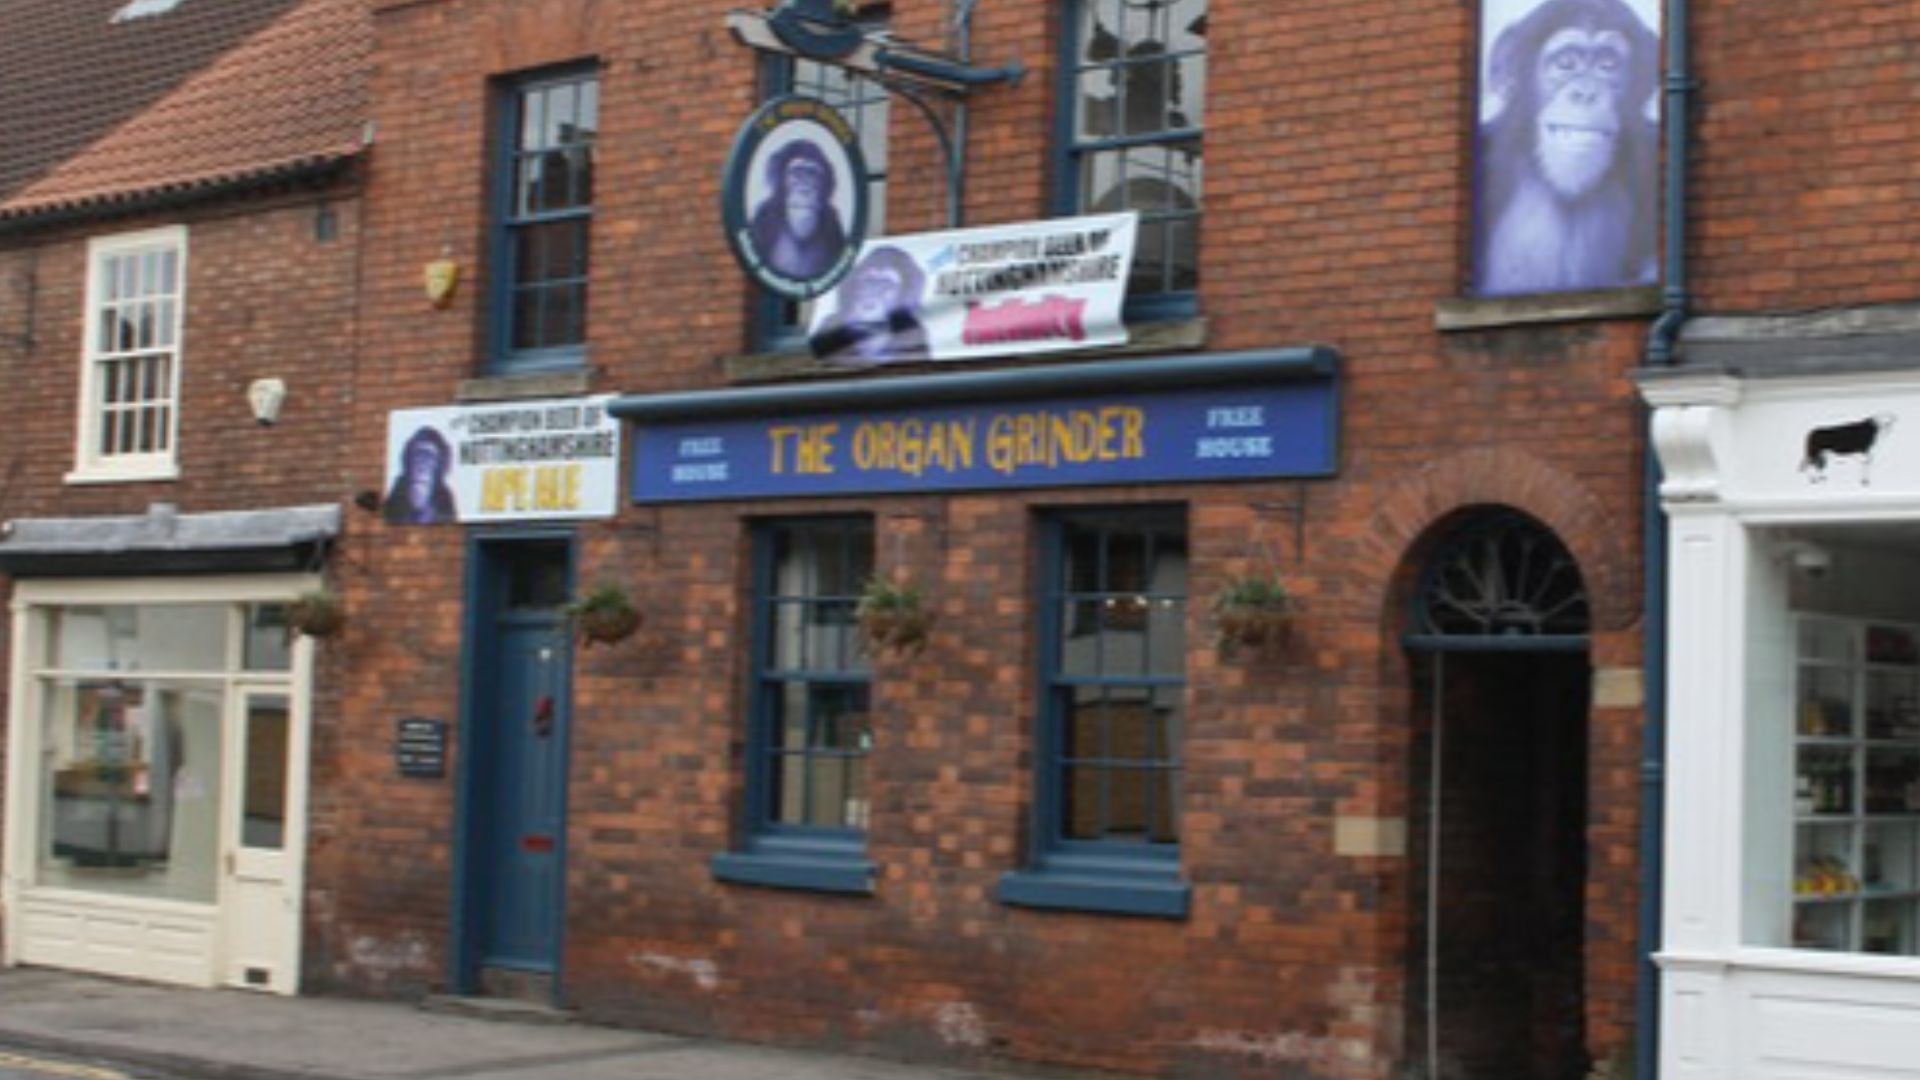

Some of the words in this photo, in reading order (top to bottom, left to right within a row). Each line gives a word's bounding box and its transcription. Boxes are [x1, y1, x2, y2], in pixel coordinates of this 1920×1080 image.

[1207, 406, 1264, 427] FREE
[768, 423, 839, 474] THE
[852, 416, 975, 478] ORGAN
[984, 404, 1145, 476] GRINDER
[1196, 436, 1273, 458] HOUSE
